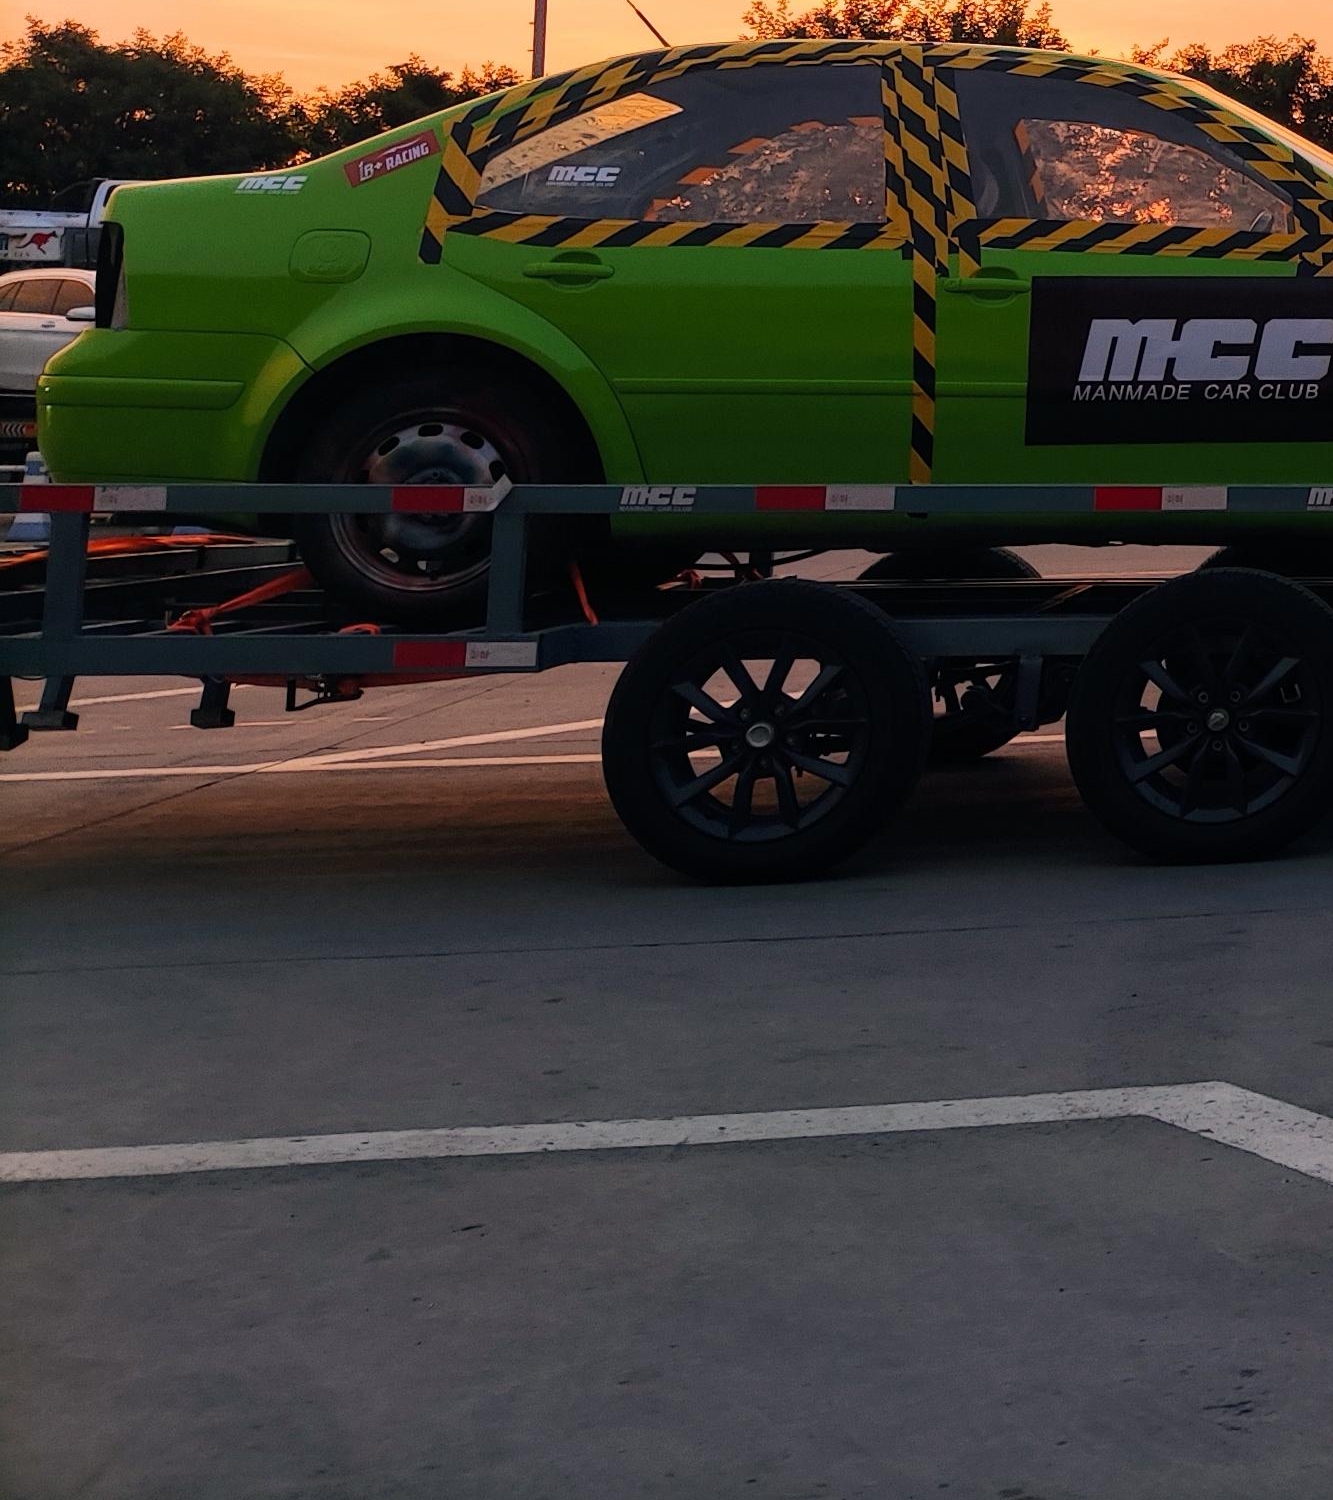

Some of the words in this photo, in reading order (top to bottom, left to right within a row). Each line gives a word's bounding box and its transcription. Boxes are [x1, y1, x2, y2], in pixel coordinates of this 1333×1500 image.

[385, 142, 429, 171] RACING
[548, 165, 621, 181] MCC
[238, 175, 308, 190] MCC
[1072, 384, 1192, 401] MANMADE
[1204, 383, 1251, 400] CAR
[1258, 383, 1319, 400] CLUB
[620, 486, 697, 506] MCC
